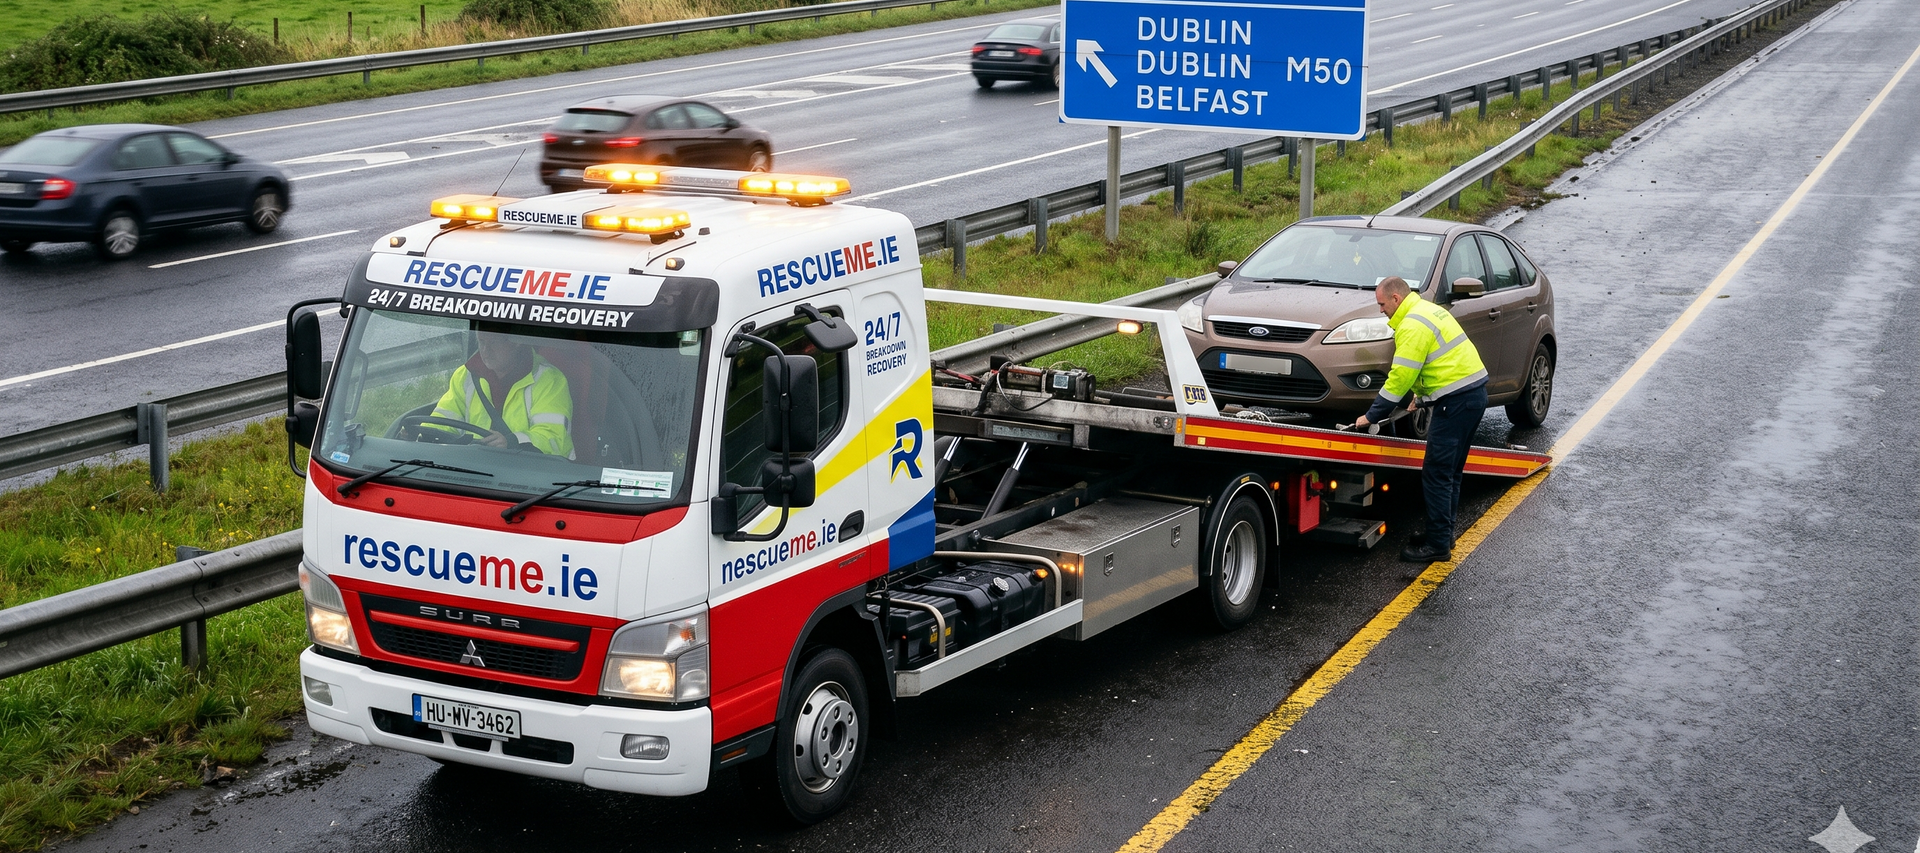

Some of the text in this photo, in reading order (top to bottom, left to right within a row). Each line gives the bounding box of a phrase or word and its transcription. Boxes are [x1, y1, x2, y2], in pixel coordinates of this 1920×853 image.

[1138, 16, 1251, 45] DUBLIN
[1137, 50, 1351, 85] DUBLIN M50
[1136, 85, 1268, 115] BELFAST
[503, 210, 577, 226] RESCUEME.IE
[403, 259, 611, 301] RESCUEME.IE
[757, 235, 900, 298] RESCUEME.IE
[367, 288, 634, 328] 24/7 BREAKDOWN RECOVERY
[864, 311, 901, 346] 24/7
[866, 340, 906, 361] BREAKDOWN
[867, 353, 907, 376] RECOVERY
[343, 533, 599, 601] rescueme.ie
